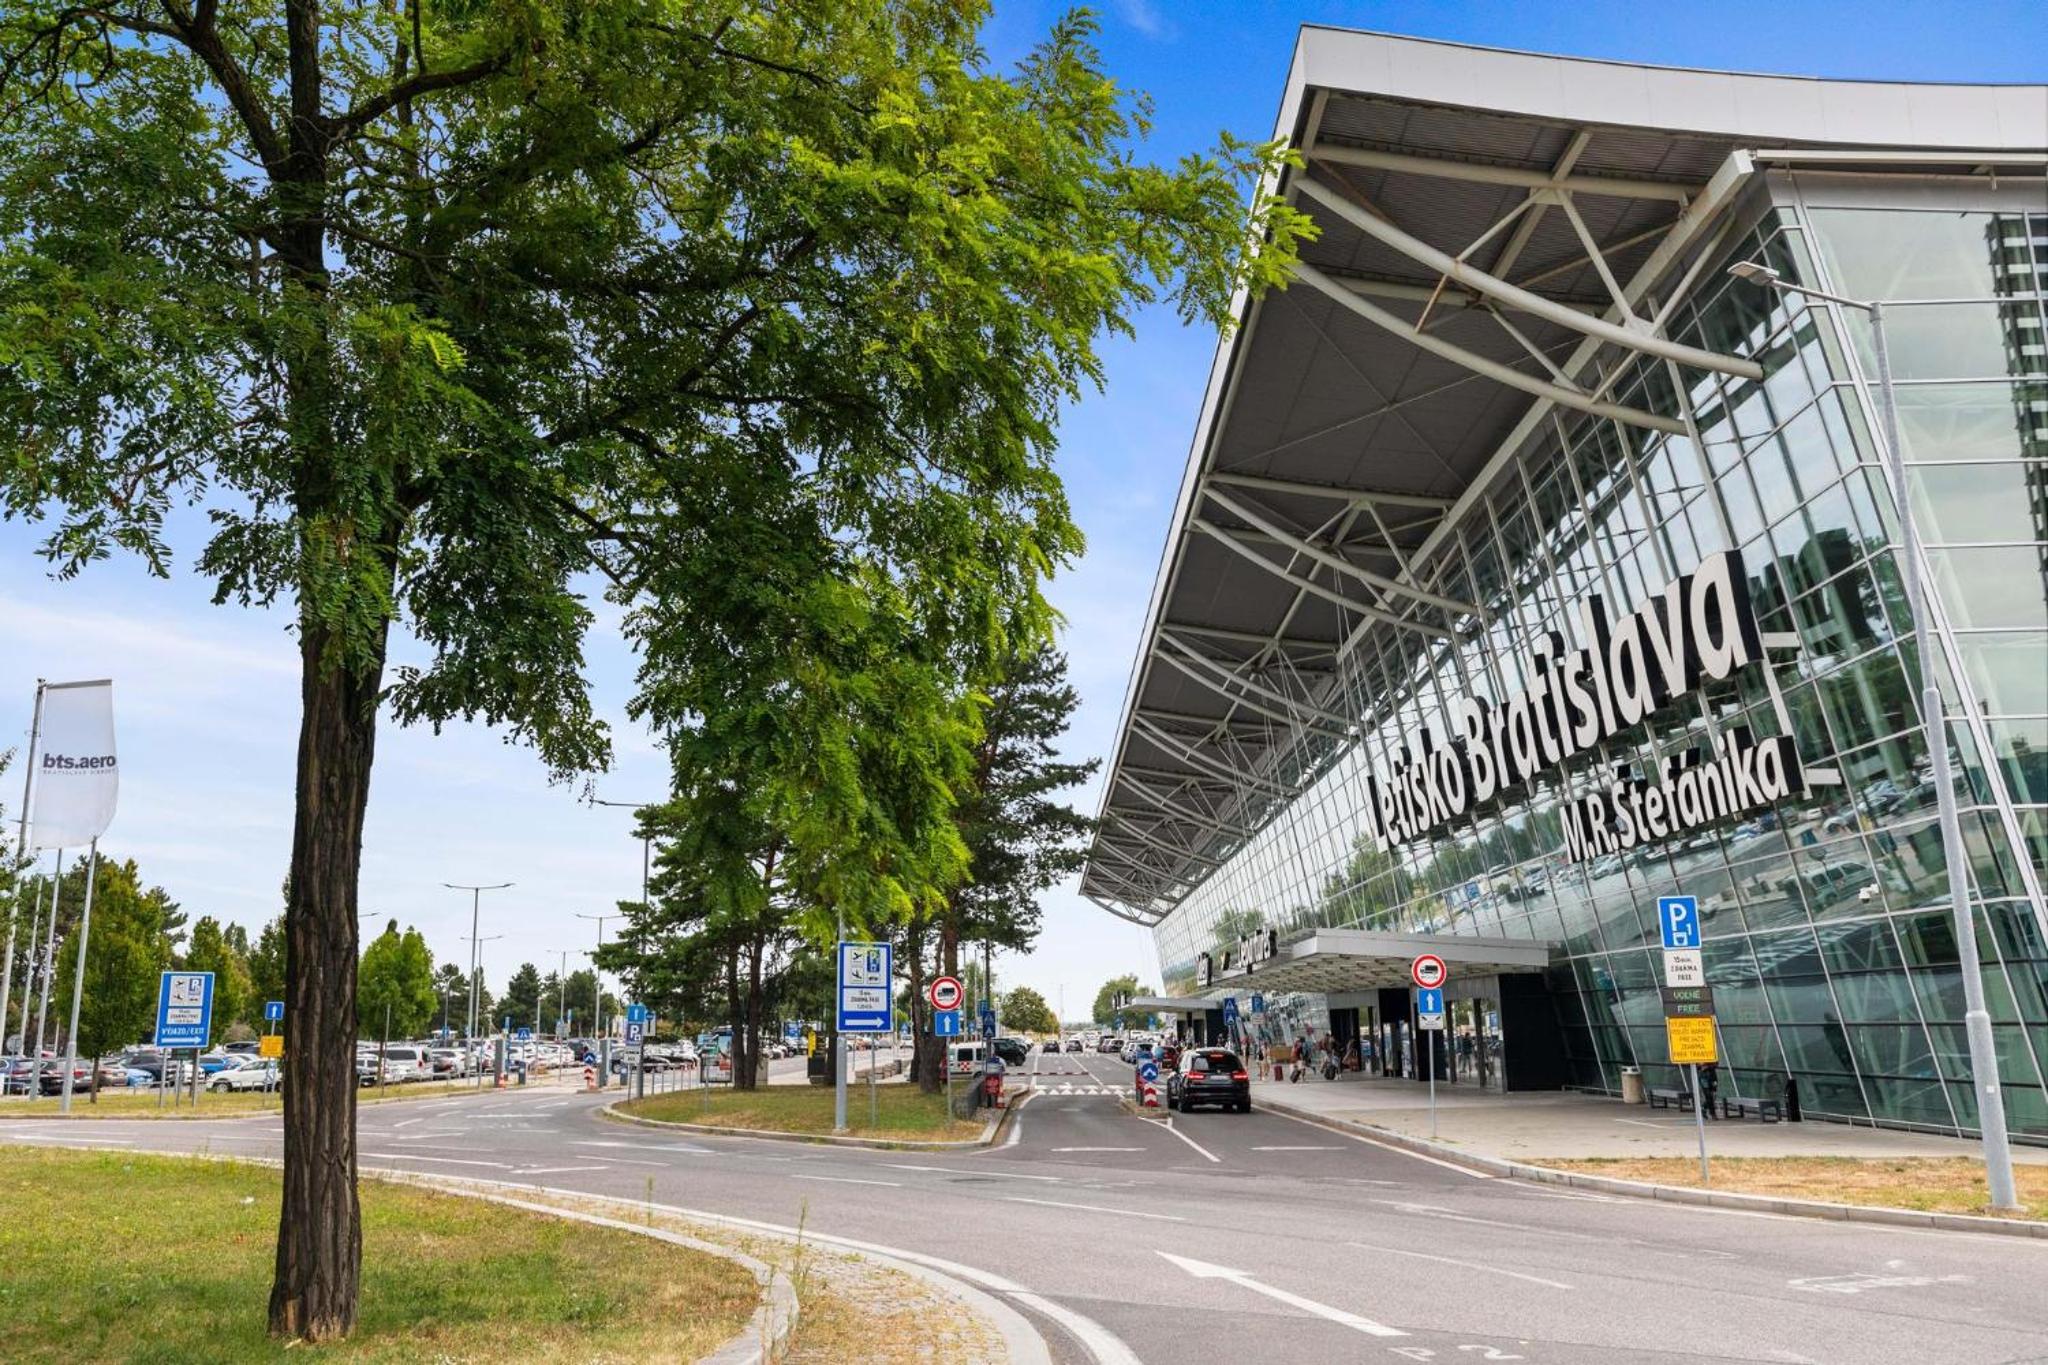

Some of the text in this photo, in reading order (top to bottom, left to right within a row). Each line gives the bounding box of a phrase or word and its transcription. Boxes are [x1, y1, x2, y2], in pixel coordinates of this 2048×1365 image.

[1366, 550, 1758, 851] Letisko Bratislava
[43, 753, 116, 769] bts.aero
[1669, 903, 1687, 931] P
[1677, 1004, 1701, 1013] FREE
[630, 1025, 640, 1038] P
